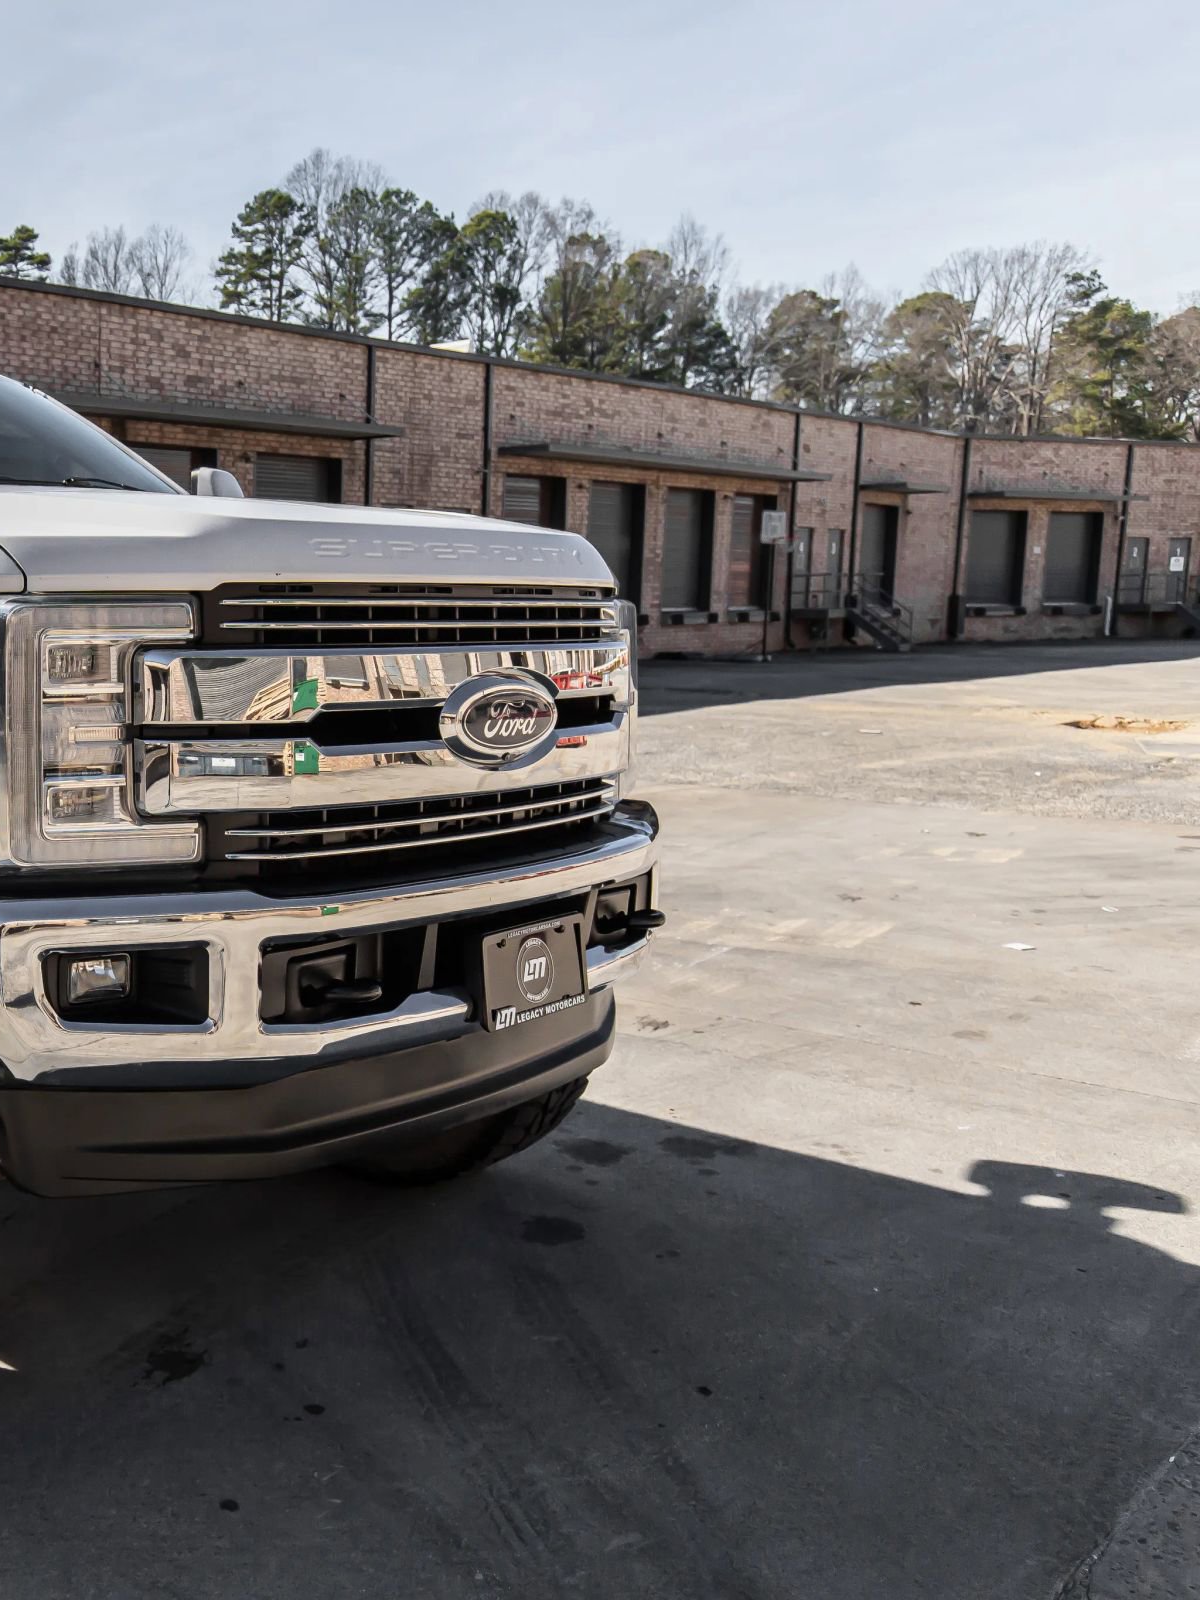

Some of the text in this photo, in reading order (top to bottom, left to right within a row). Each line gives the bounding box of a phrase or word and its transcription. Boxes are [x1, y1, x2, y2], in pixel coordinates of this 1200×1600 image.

[484, 699, 537, 738] Ford
[516, 1007, 544, 1024] LEGACY
[545, 994, 585, 1014] MOTORCARS
